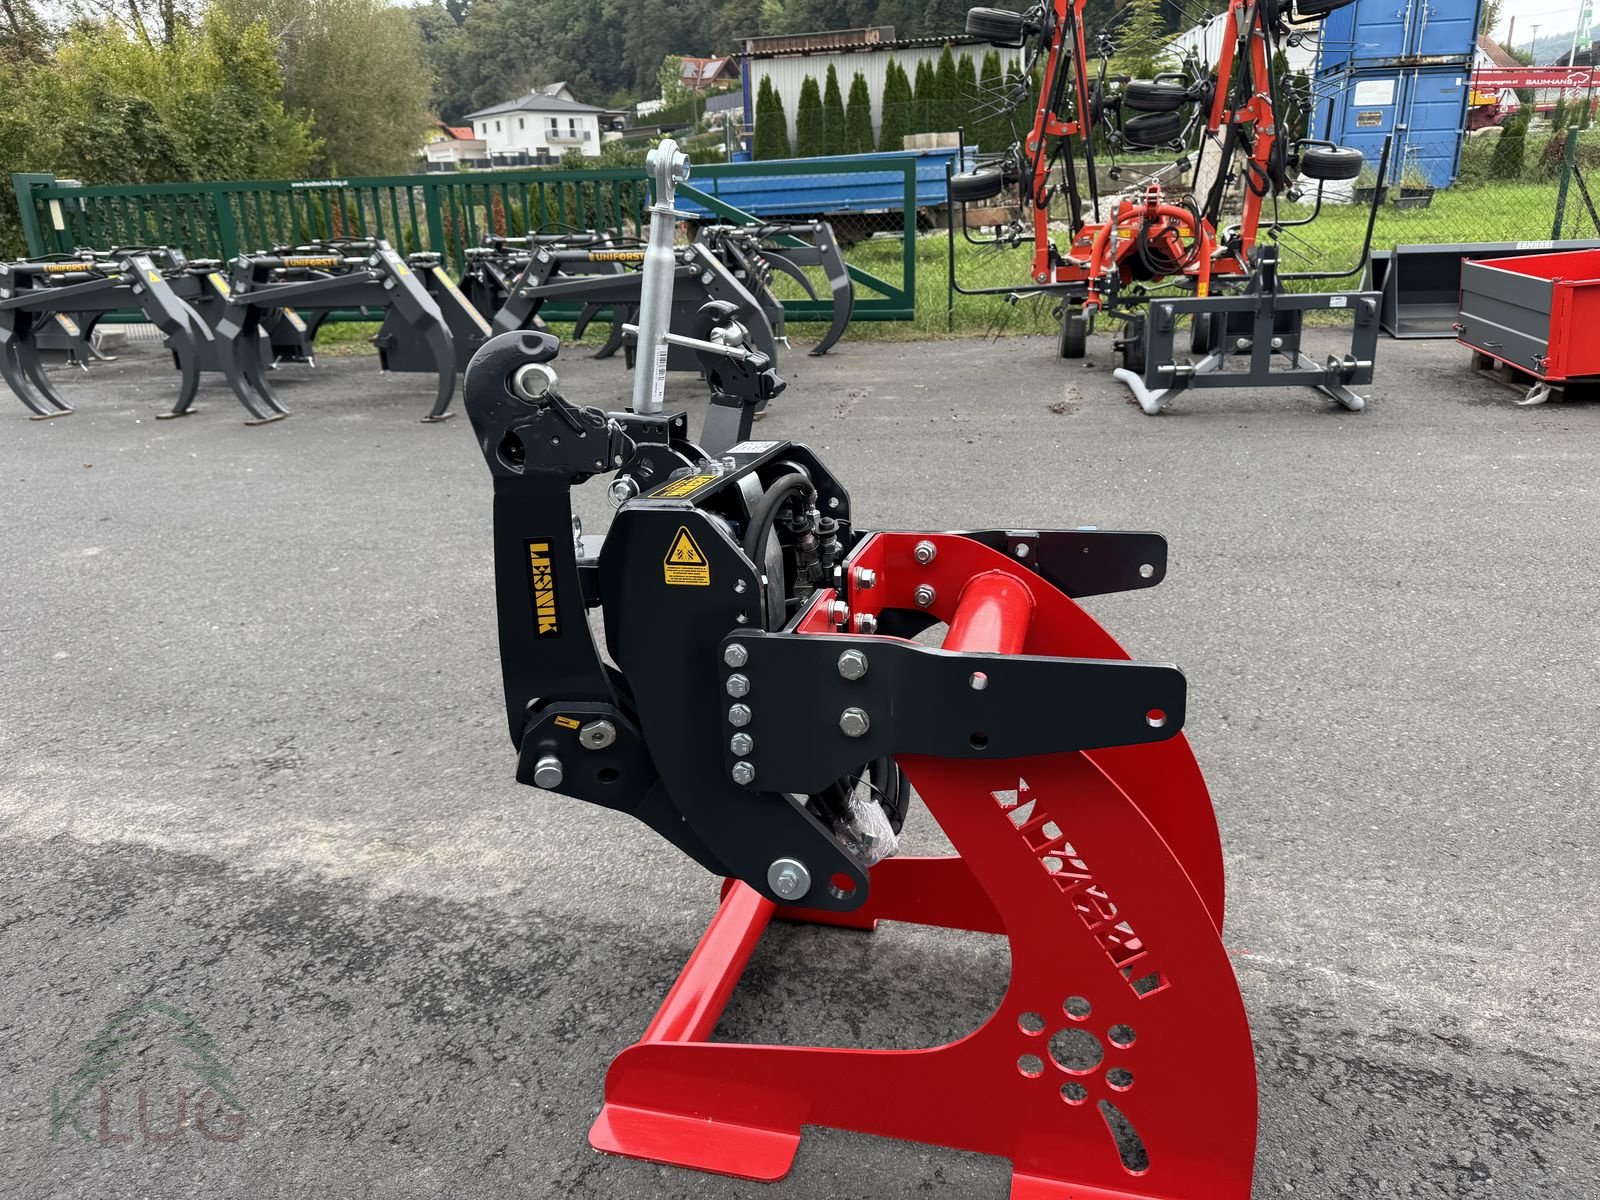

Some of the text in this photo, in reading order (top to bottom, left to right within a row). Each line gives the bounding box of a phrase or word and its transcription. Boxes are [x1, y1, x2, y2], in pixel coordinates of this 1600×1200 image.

[594, 252, 645, 261] UNIFORST
[290, 258, 333, 267] UNIFORST
[529, 543, 558, 635] LESNIK
